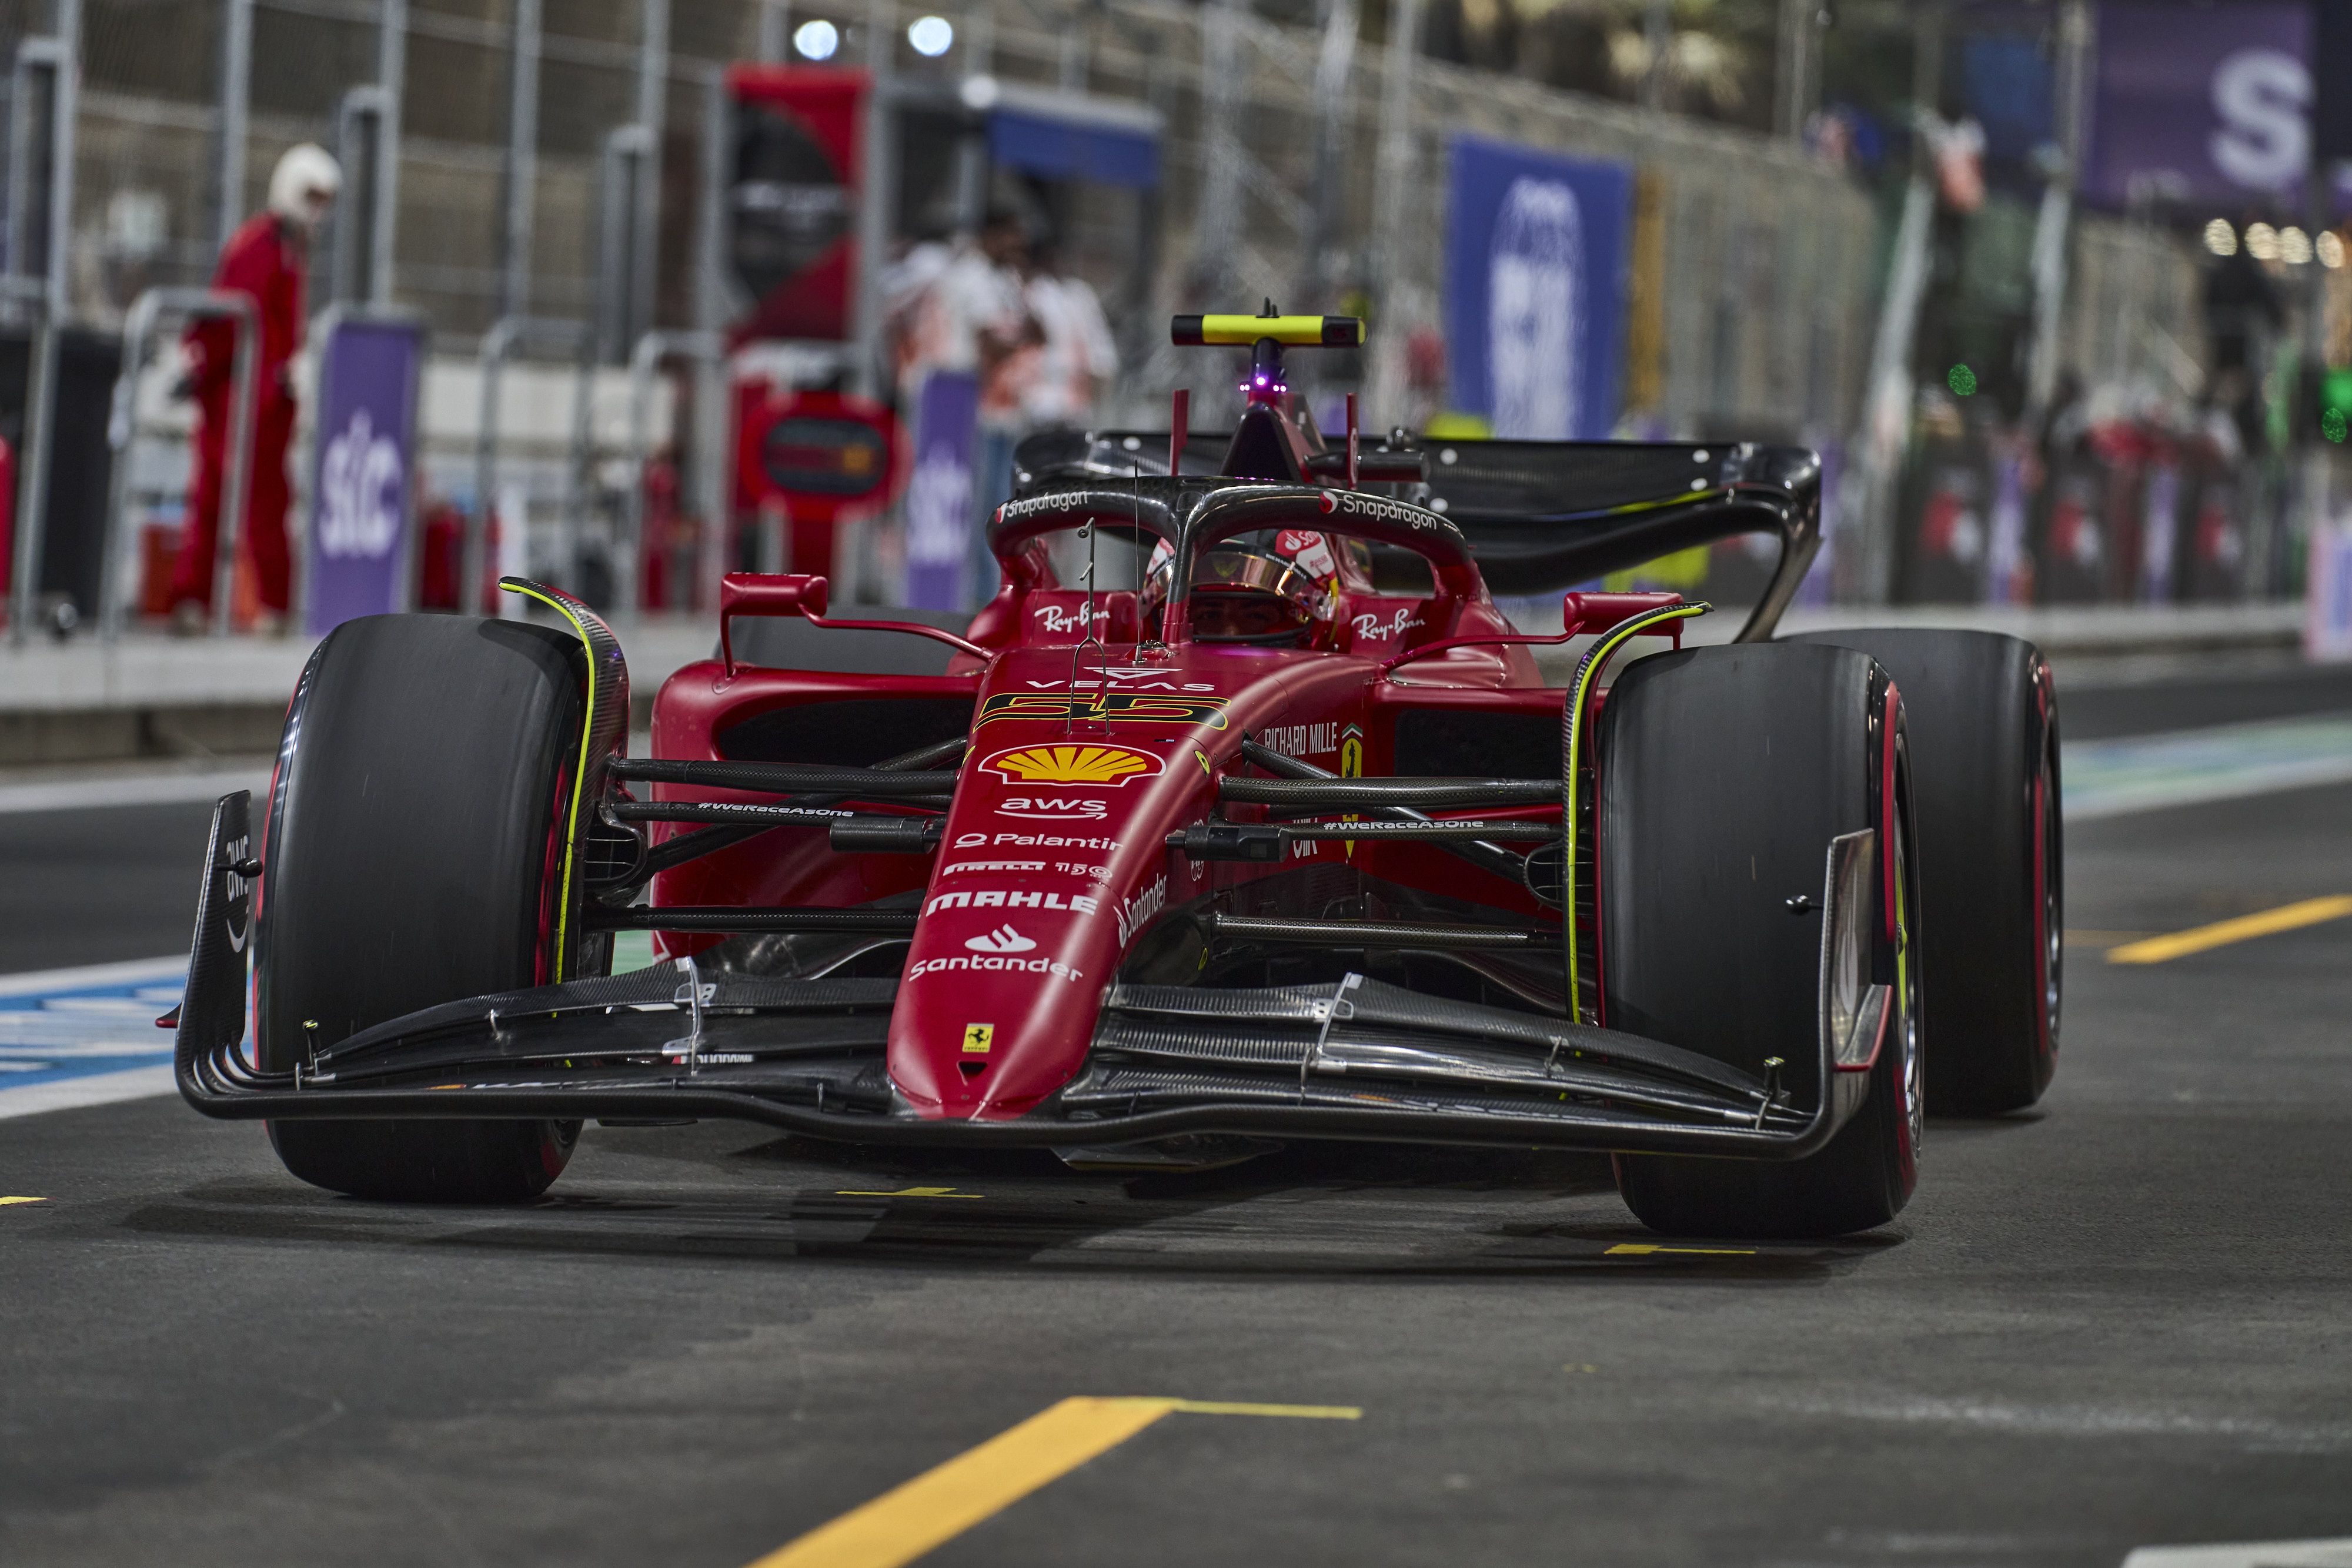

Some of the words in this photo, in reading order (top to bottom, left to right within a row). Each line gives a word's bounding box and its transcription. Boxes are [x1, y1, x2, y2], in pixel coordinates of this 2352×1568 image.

[1007, 490, 1088, 517] Snapdragon
[1343, 494, 1437, 530] Snapdragon
[1034, 601, 1111, 633] Ray-Ban
[1351, 608, 1426, 641] Ray-Ban
[1026, 680, 1215, 691] VELAS
[972, 693, 1232, 734] 55
[1265, 725, 1307, 756] RICHARD
[1309, 721, 1338, 754] MILLE
[698, 803, 854, 818] #WeRaceAsOne
[1001, 798, 1107, 812] aws
[1324, 820, 1484, 830] #WeRaceAsOne
[993, 833, 1124, 851] Palantir
[926, 891, 1098, 916] MAHLE
[1124, 872, 1167, 938] Santander
[908, 954, 1083, 982] Santander
